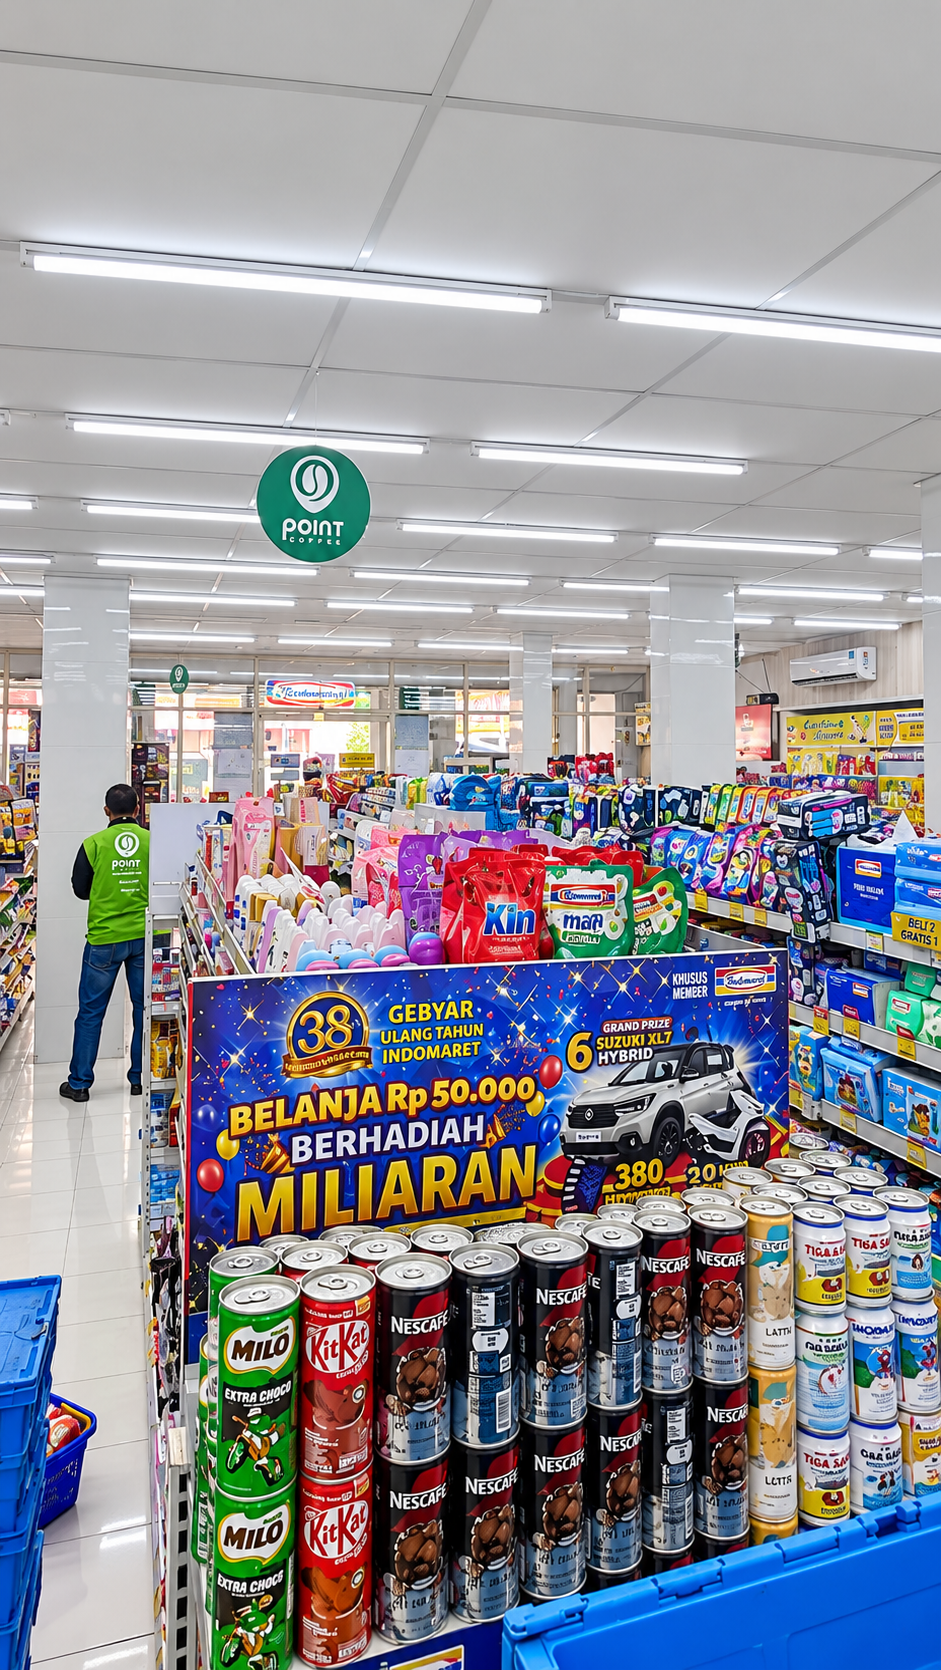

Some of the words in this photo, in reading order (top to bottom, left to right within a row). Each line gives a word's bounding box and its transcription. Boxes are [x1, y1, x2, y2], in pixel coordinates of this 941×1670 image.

[282, 518, 344, 540] POINT
[112, 859, 141, 870] POINT
[483, 902, 535, 935] Kin
[908, 917, 928, 932] BELI
[927, 922, 935, 933] 2
[901, 930, 931, 945] GRATIS
[933, 936, 938, 946] 1
[672, 971, 708, 986] KHUSUS
[672, 986, 708, 1000] MEMBER
[388, 1000, 474, 1023] GEBYAR
[297, 1004, 354, 1053] 38
[380, 1028, 432, 1045] ULANG
[435, 1023, 484, 1039] TAHUN
[602, 1021, 641, 1034] GRAND
[641, 1018, 671, 1030] PRIZE
[382, 1041, 482, 1064] INDOMARET
[567, 1032, 593, 1071] 6
[596, 1034, 645, 1051] SUZUKI
[647, 1031, 673, 1046] XL7
[598, 1048, 654, 1066] HYBRID
[230, 1085, 382, 1136] BELANJA
[387, 1081, 428, 1117] Rp
[431, 1076, 537, 1108] 50.000
[292, 1114, 485, 1164] BERHADIAH
[615, 1158, 664, 1191] 380
[687, 1164, 716, 1185] 20
[236, 1145, 537, 1242] MILIARAN
[231, 1332, 290, 1362] MILO
[309, 1320, 368, 1372] KitKat
[224, 1387, 257, 1404] EXTRA
[259, 1380, 292, 1403] CHOCO
[223, 1519, 285, 1550] MILO
[308, 1502, 367, 1558] KitKat
[217, 1573, 247, 1594] EXTRA
